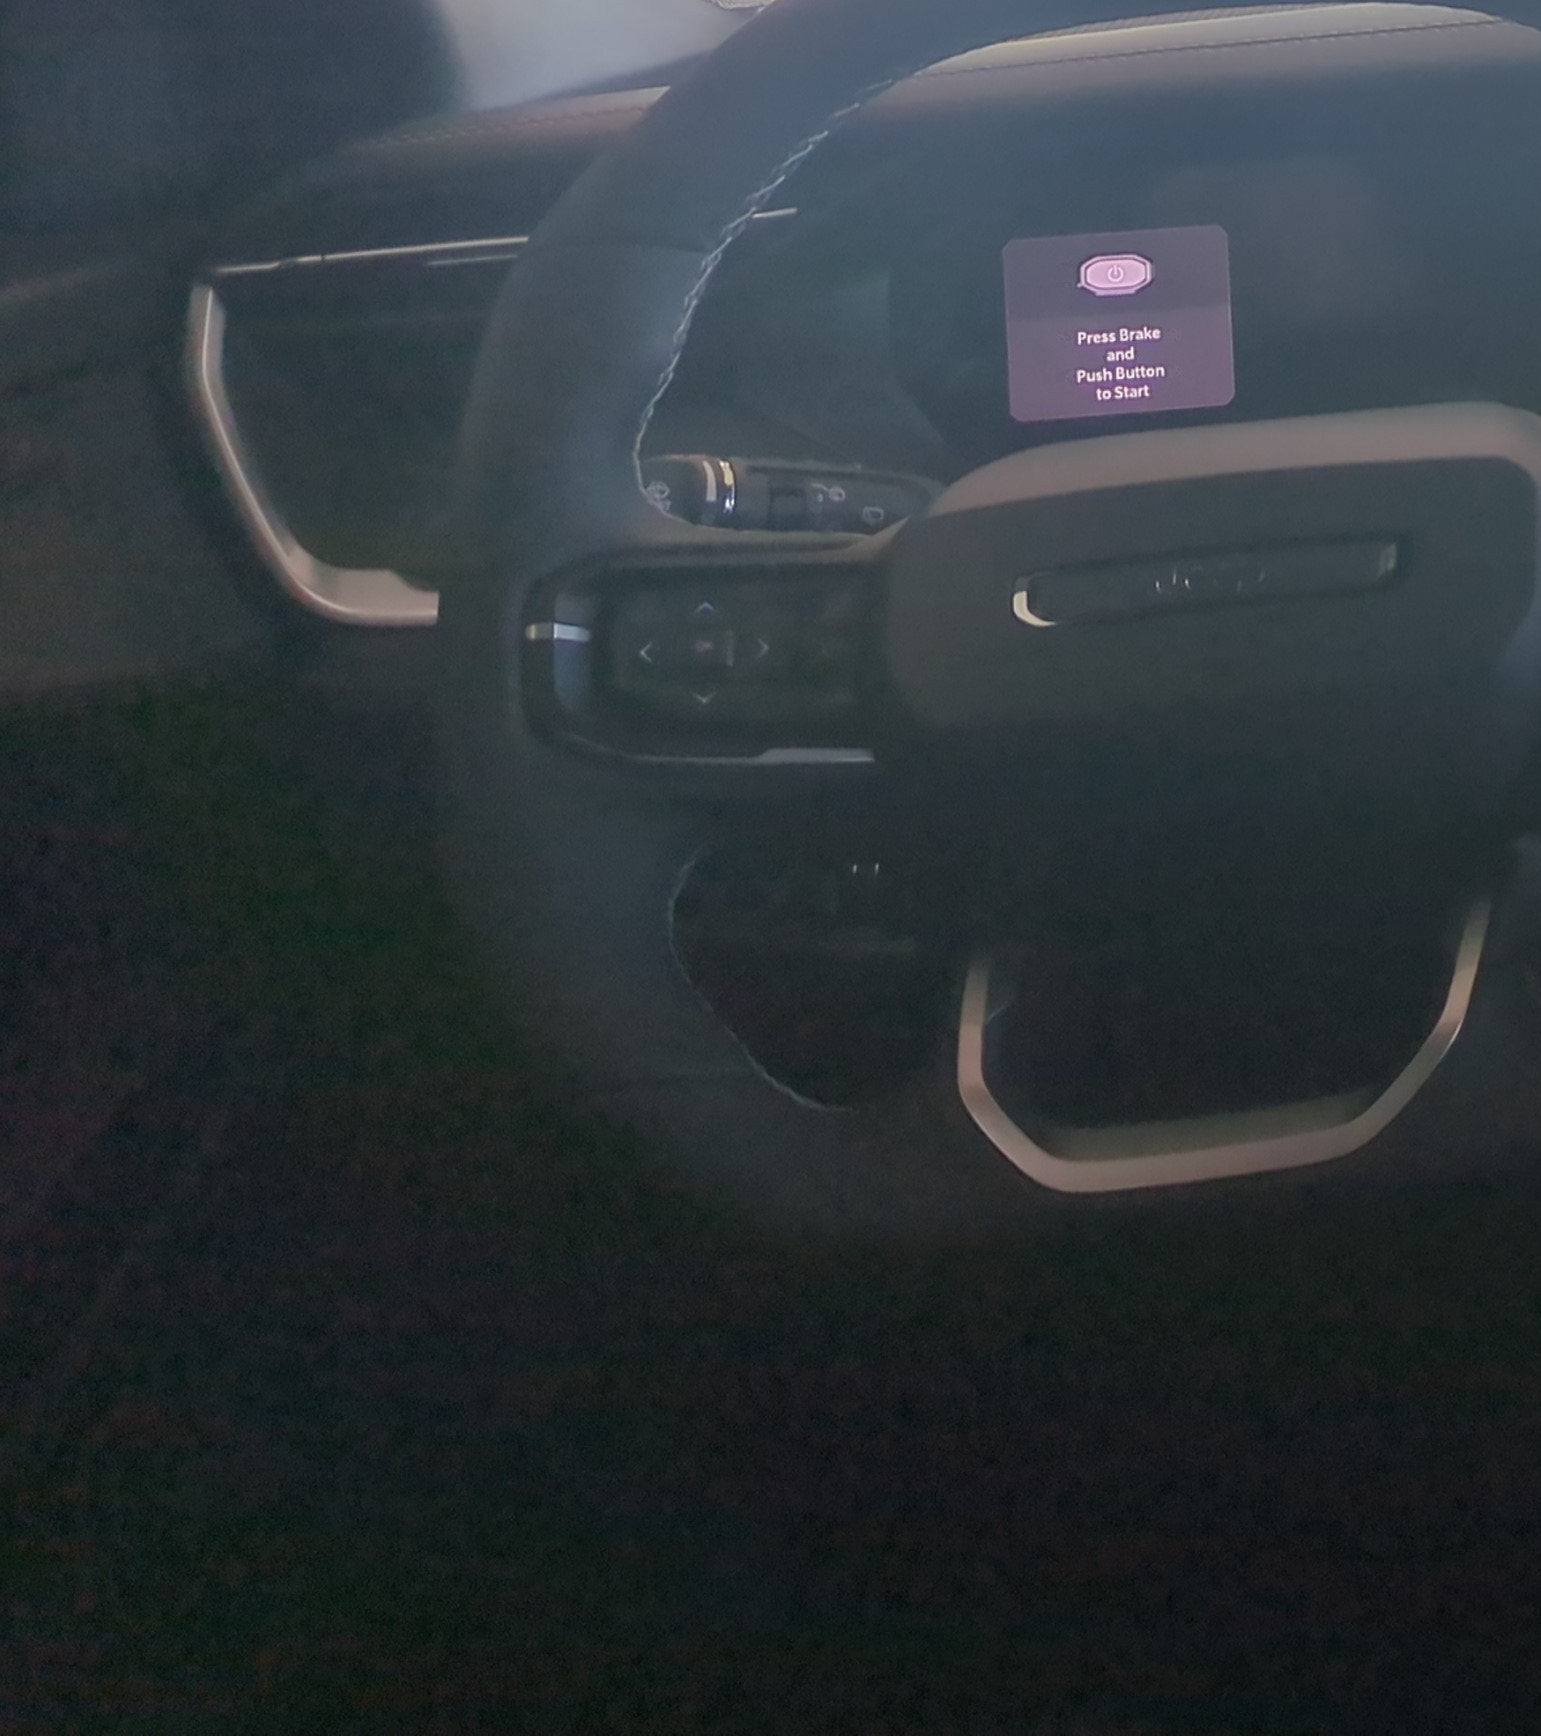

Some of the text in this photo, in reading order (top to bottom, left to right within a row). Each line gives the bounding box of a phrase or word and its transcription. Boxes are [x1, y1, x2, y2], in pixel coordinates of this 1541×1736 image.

[1077, 326, 1162, 346] Press Brake
[1106, 346, 1135, 362] and
[1076, 365, 1166, 384] Push Button
[1095, 384, 1150, 401] to Start
